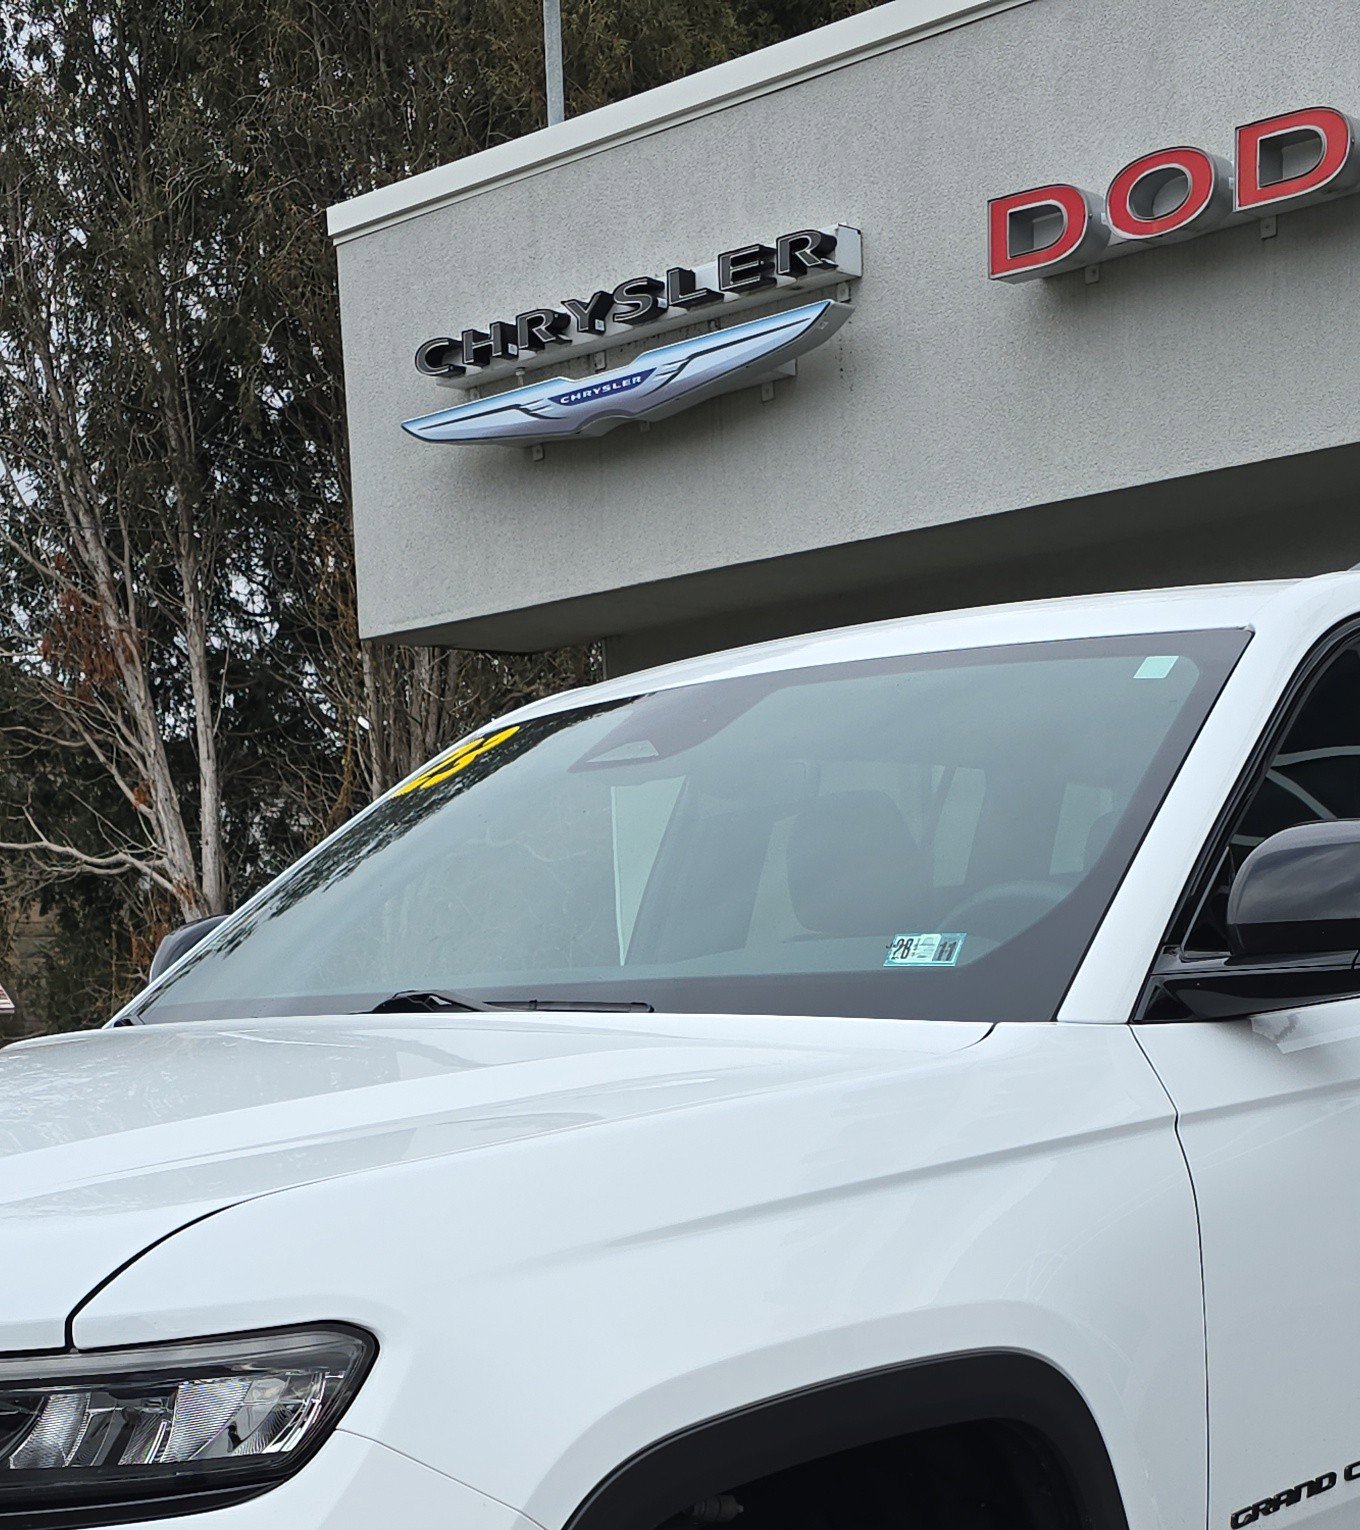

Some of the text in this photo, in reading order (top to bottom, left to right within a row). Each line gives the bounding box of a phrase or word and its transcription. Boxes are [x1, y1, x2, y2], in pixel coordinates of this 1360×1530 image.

[415, 229, 838, 378] CHRYSLER
[560, 376, 642, 405] CHRYSLER
[1230, 1471, 1337, 1530] GRAND
